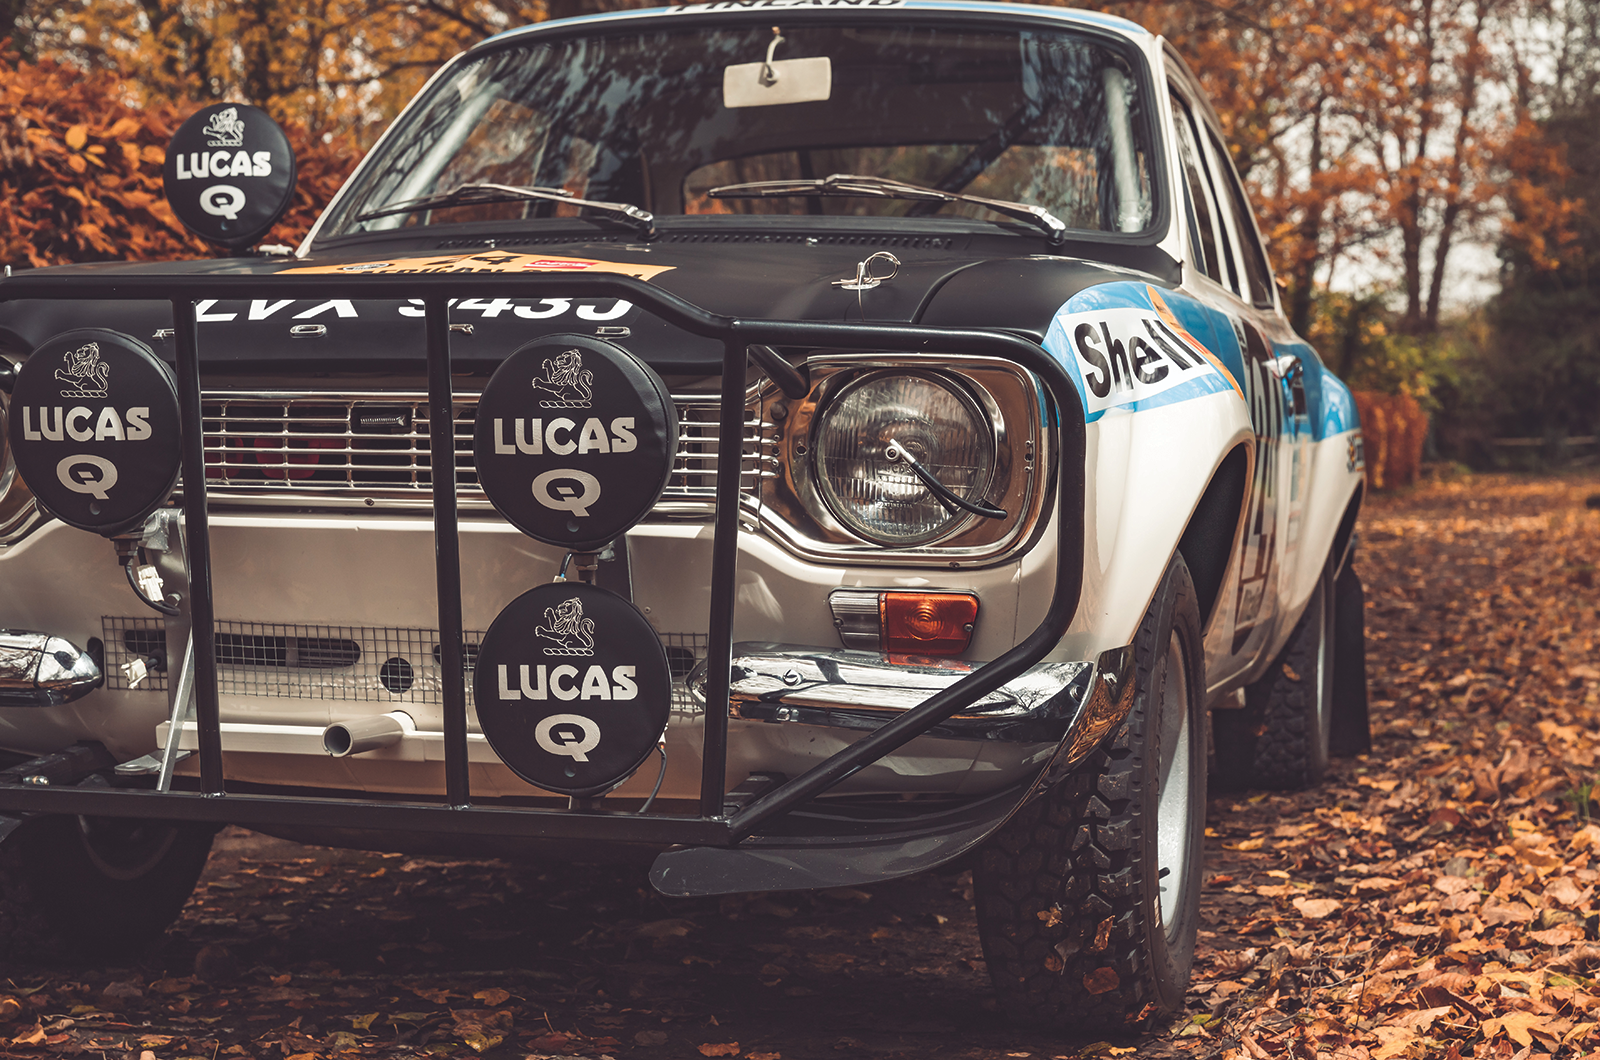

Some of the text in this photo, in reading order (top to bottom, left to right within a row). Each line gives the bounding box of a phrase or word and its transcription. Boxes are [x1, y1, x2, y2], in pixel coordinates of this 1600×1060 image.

[177, 151, 272, 180] LUCAS
[200, 185, 245, 220] Q
[1074, 319, 1207, 398] Shell
[23, 406, 152, 442] LUCAS
[493, 416, 638, 456] LUCAS
[56, 455, 118, 500] Q
[532, 469, 601, 517] Q
[498, 664, 639, 701] LUCAS
[535, 714, 601, 762] Q
